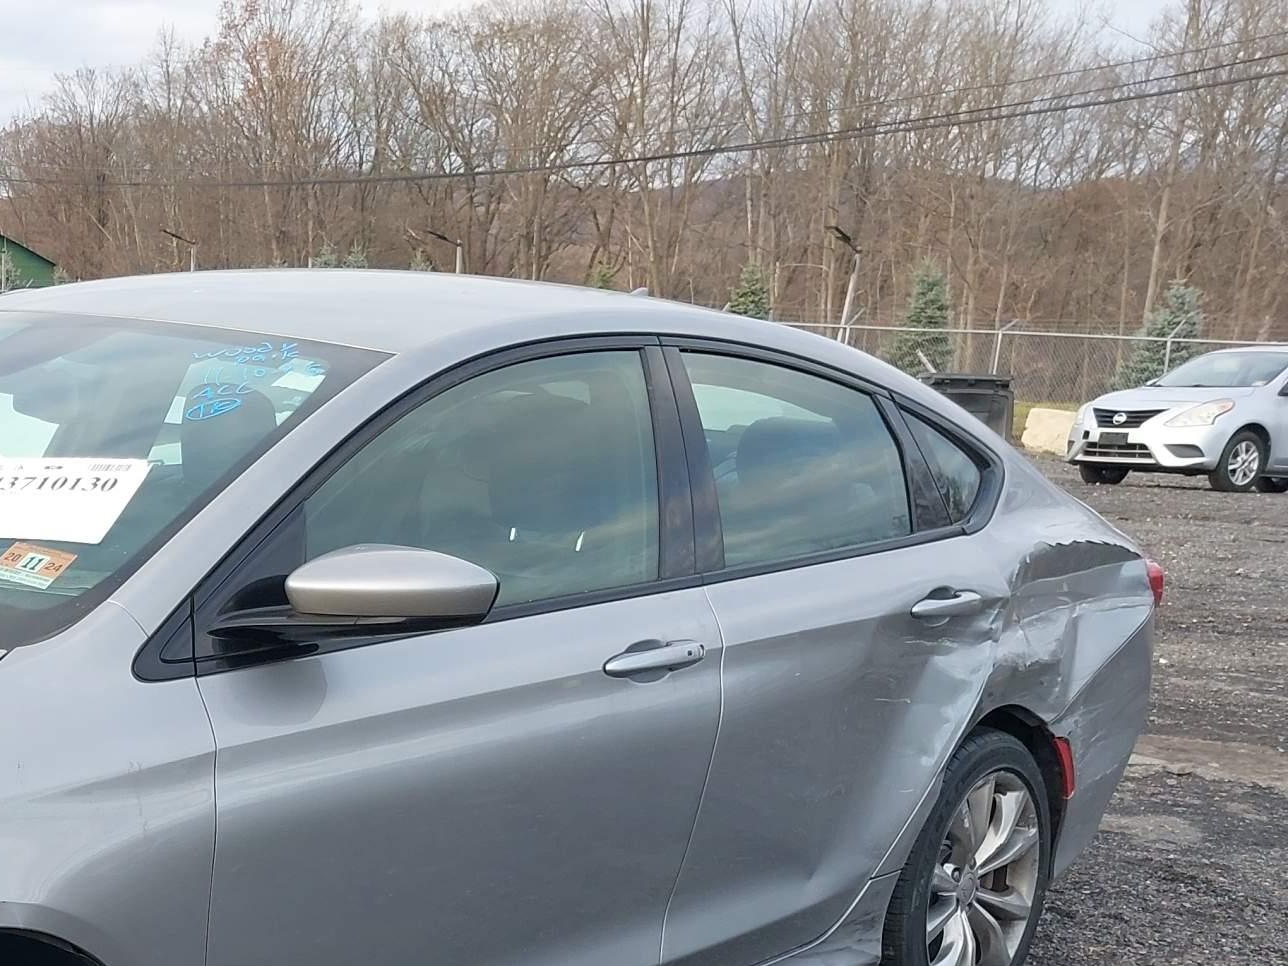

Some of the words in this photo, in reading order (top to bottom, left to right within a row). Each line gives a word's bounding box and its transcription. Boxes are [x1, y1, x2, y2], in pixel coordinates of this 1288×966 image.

[4, 552, 22, 562] 20
[21, 555, 46, 571] 11
[44, 562, 64, 573] 24
